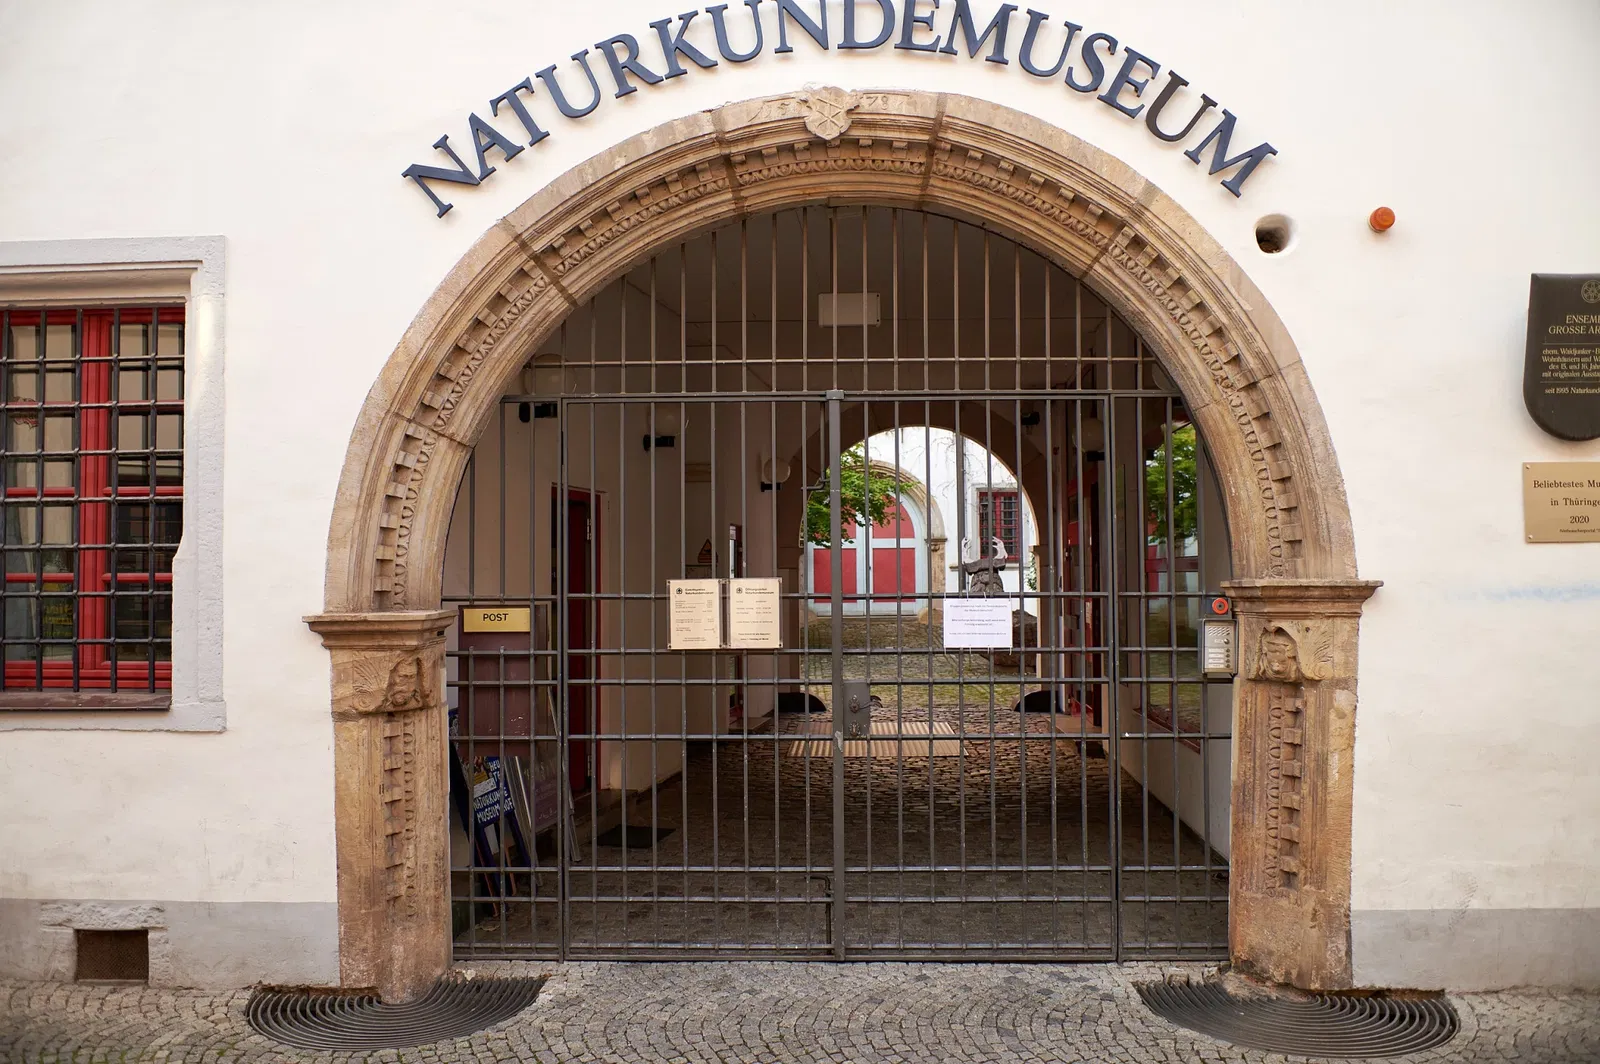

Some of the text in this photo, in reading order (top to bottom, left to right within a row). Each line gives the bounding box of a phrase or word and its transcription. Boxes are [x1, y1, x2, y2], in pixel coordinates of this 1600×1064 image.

[401, 0, 1278, 219] NATURKUNDEMUSEUM
[1548, 325, 1586, 335] GROSSE
[1533, 480, 1584, 488] Beliebtestes
[1550, 498, 1559, 506] in
[1569, 515, 1590, 524] 2020
[482, 613, 509, 622] POST
[473, 786, 508, 811] NATURKUNE
